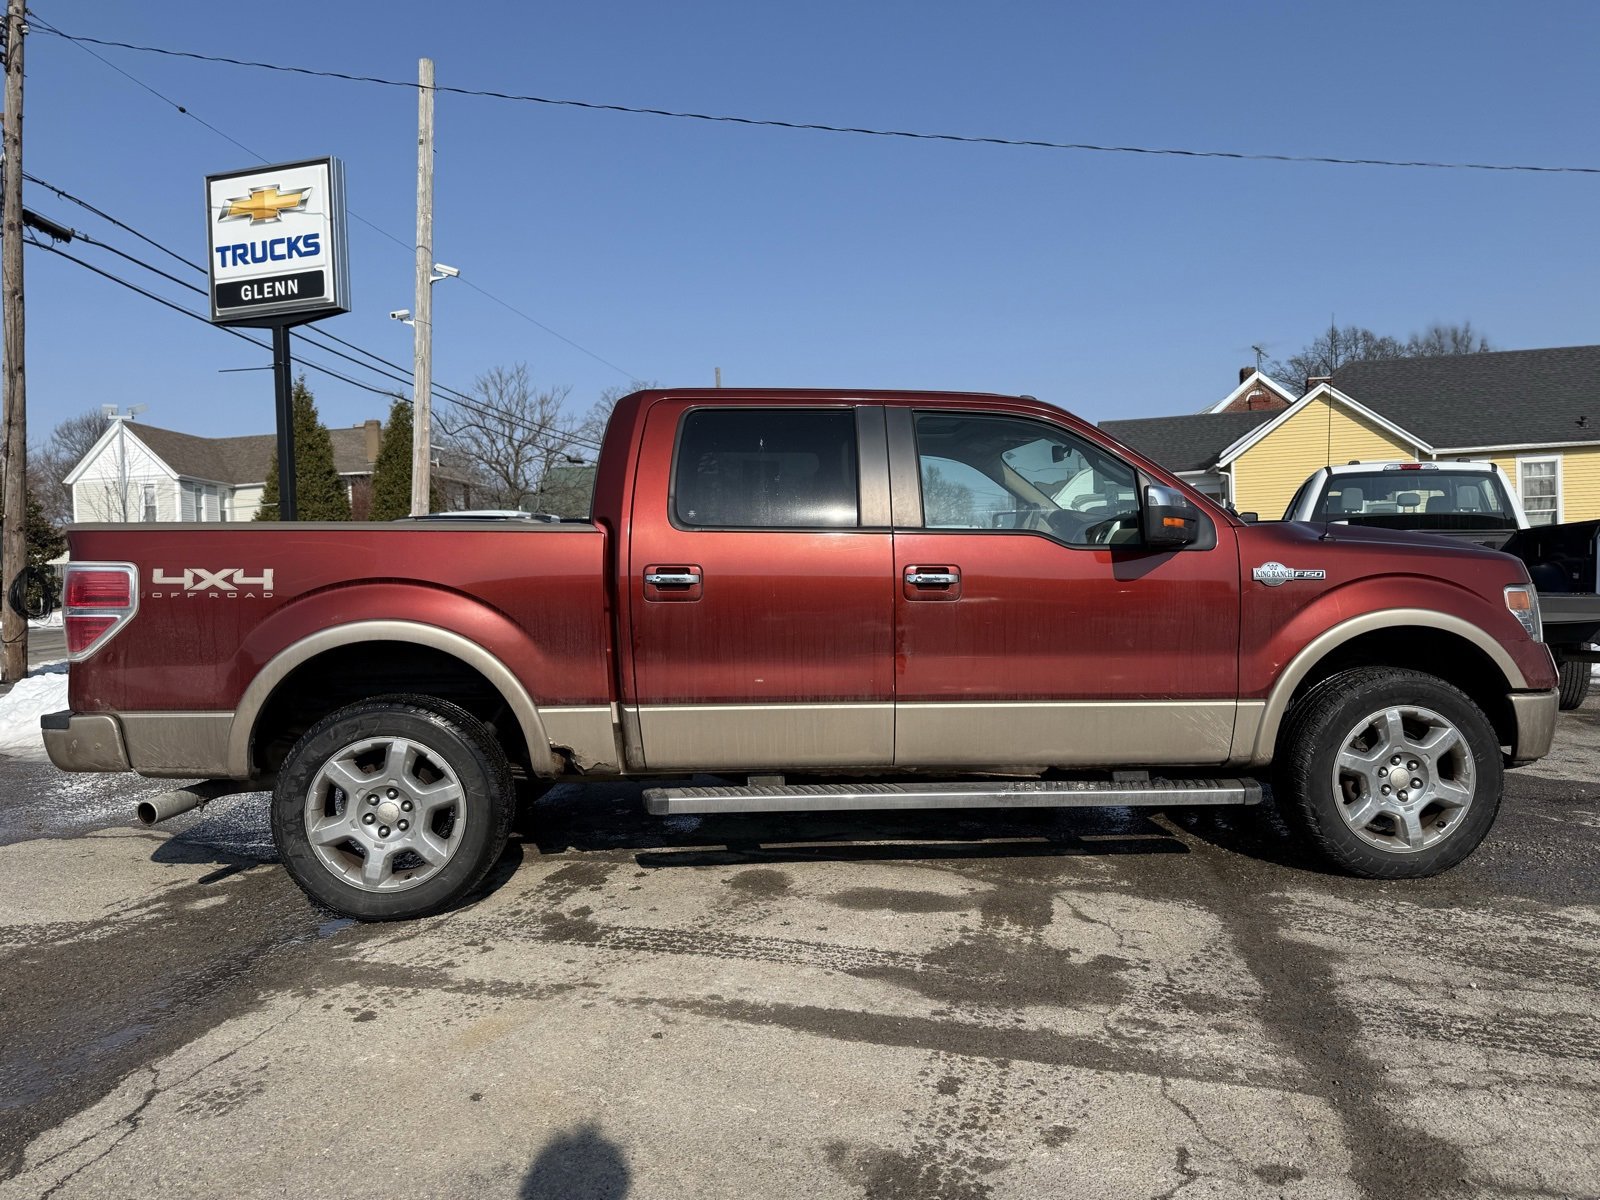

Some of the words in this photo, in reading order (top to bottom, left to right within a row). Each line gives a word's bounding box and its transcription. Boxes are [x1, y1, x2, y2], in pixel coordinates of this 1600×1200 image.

[215, 233, 321, 268] TRUCKS
[240, 279, 299, 301] GLENN
[1255, 569, 1271, 578] KING
[1272, 569, 1293, 578] RANCH
